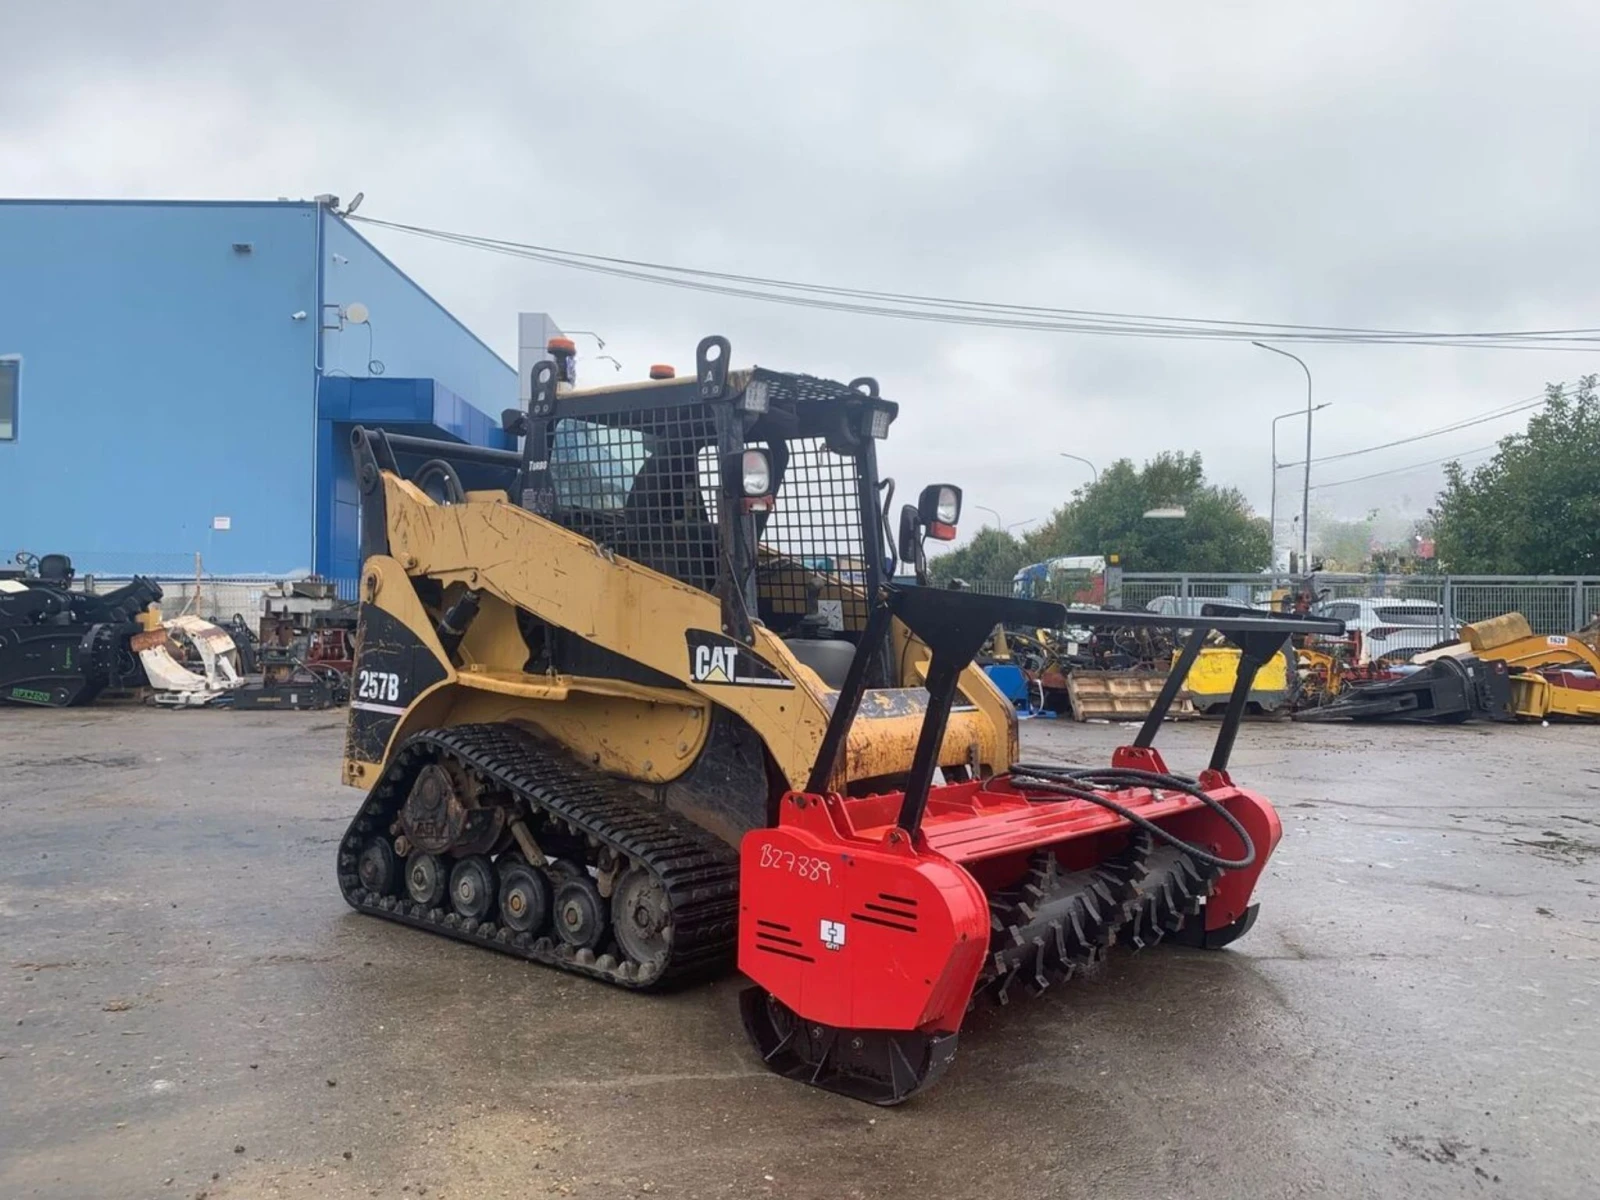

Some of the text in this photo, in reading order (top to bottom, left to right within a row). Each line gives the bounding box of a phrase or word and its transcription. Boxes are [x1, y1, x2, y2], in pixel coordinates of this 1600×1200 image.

[695, 645, 738, 682] CAT
[359, 670, 400, 702] 257B
[760, 843, 831, 886] B27889
